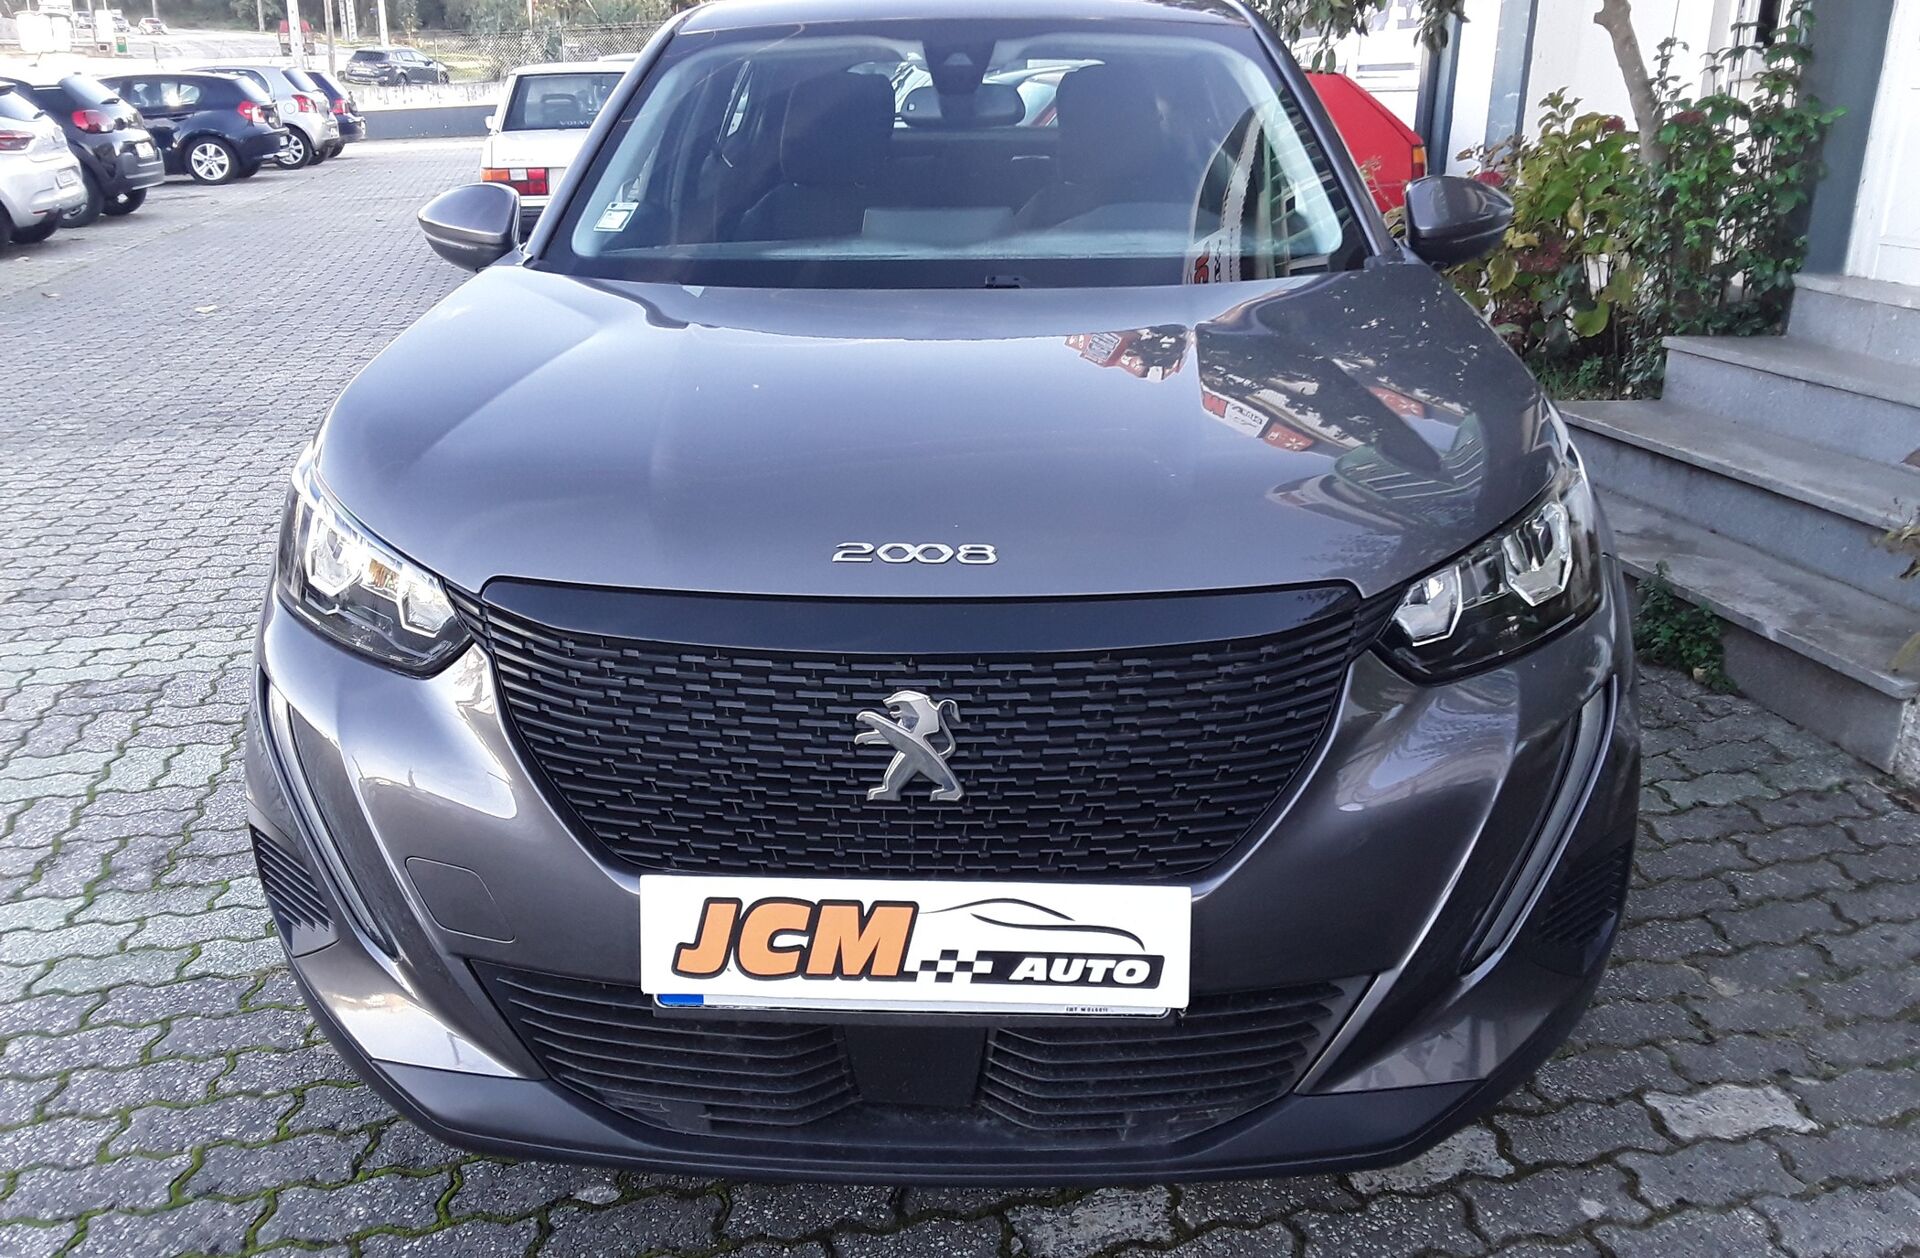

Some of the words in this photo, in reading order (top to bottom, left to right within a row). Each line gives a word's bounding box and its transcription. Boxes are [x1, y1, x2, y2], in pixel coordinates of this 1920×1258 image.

[831, 542, 999, 565] 2008
[671, 896, 919, 982] JCM
[1009, 957, 1152, 985] AUTO
